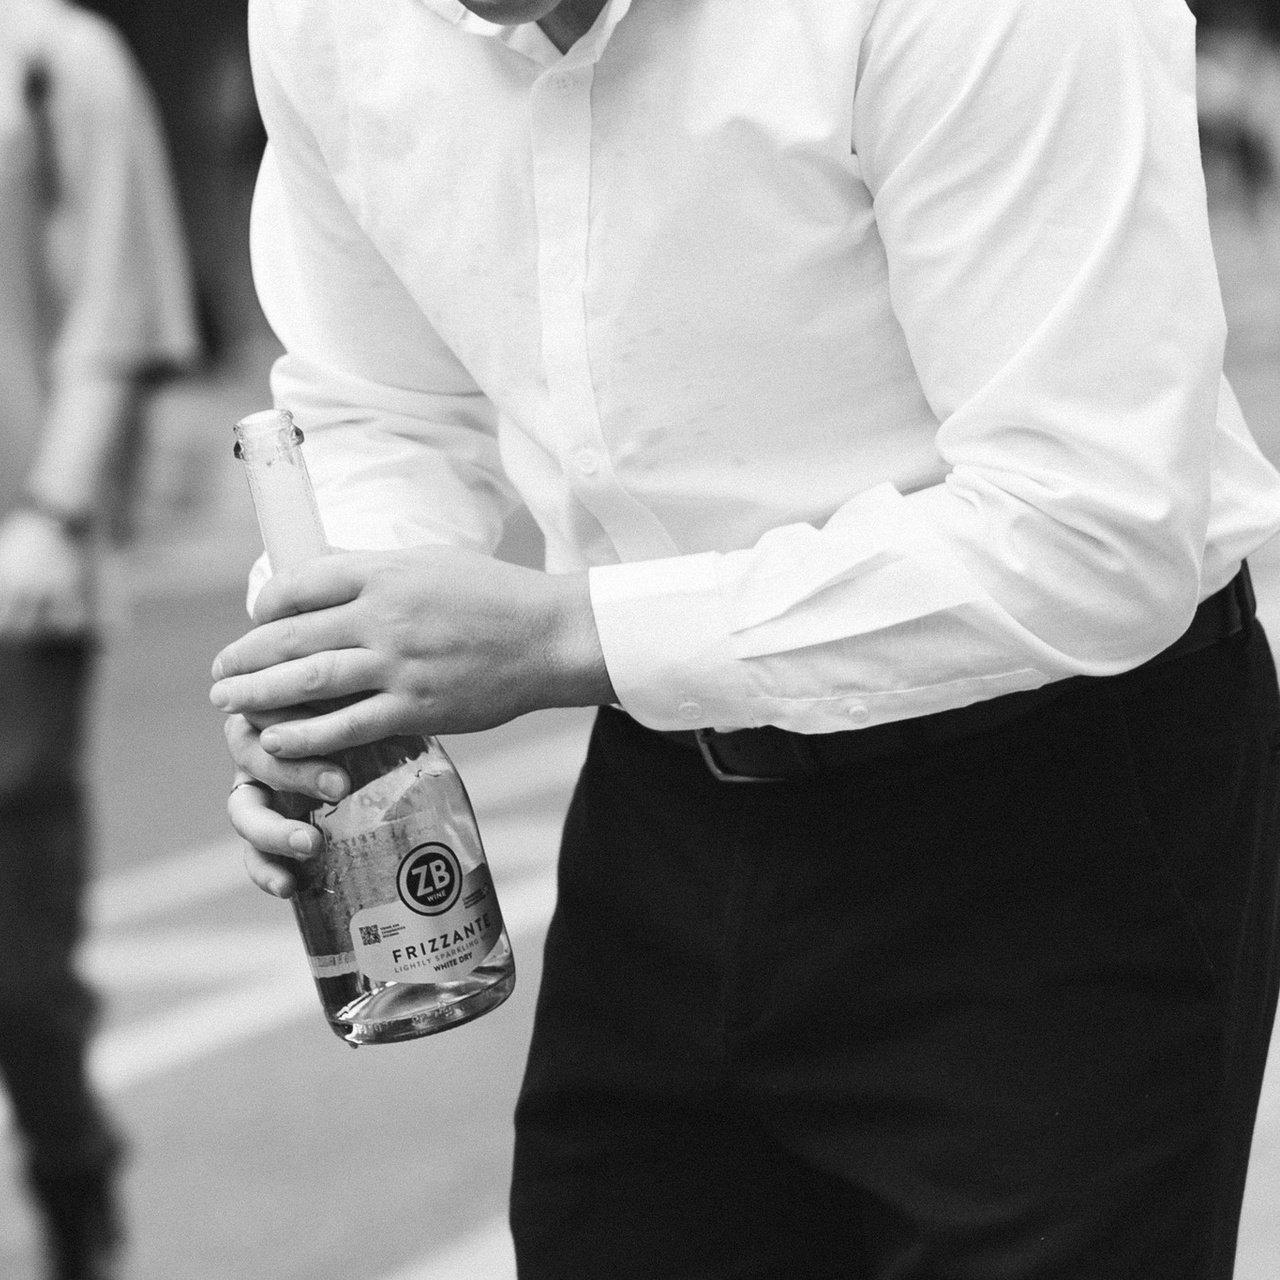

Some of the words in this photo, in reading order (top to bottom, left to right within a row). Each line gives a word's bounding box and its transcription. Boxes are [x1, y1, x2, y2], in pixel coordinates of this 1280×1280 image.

[411, 859, 451, 897] ZB
[426, 889, 447, 902] WINE
[392, 913, 491, 963] FRIZZANTE
[394, 958, 432, 974] LIGHTLY
[435, 938, 480, 962] SPARKLING
[433, 956, 459, 972] WHITE
[458, 951, 473, 964] DRY
